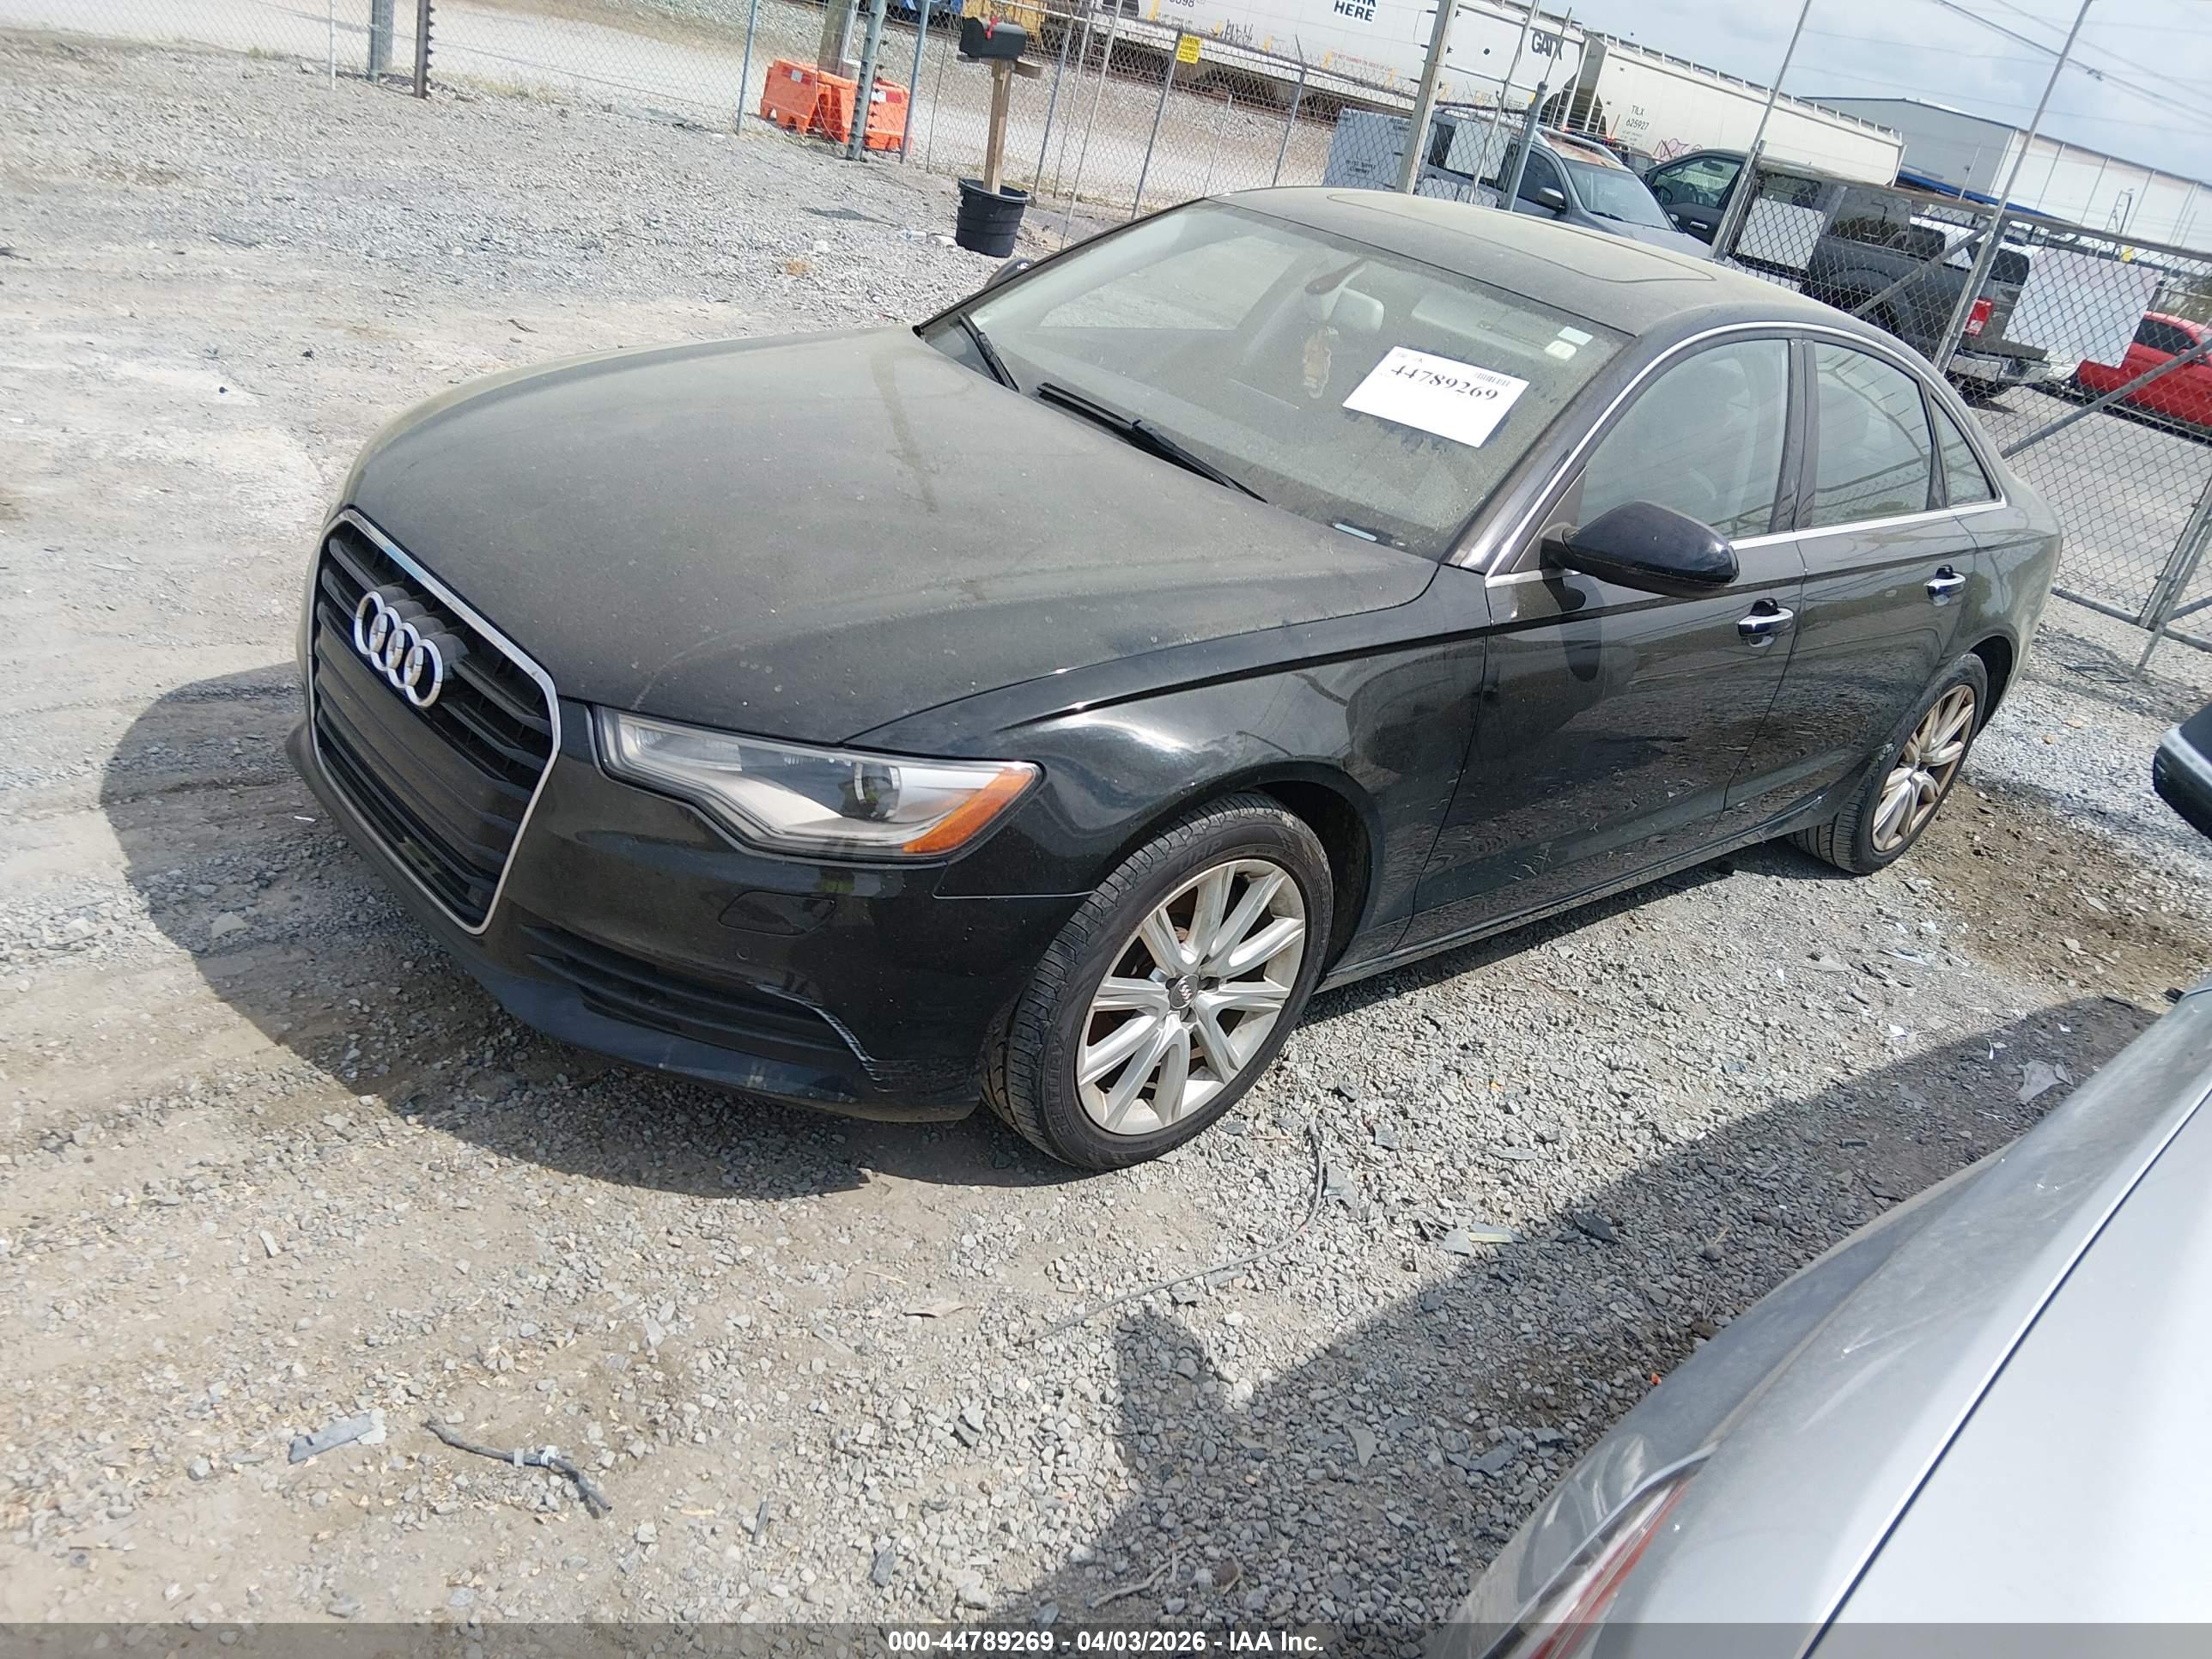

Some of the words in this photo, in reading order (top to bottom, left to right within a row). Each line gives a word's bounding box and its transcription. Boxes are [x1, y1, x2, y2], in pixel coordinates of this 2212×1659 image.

[1334, 1, 1375, 22] HERE
[1531, 31, 1564, 60] GATX
[1632, 105, 1644, 116] TILX
[1626, 118, 1649, 131] 625927
[1391, 365, 1498, 400] 44789269
